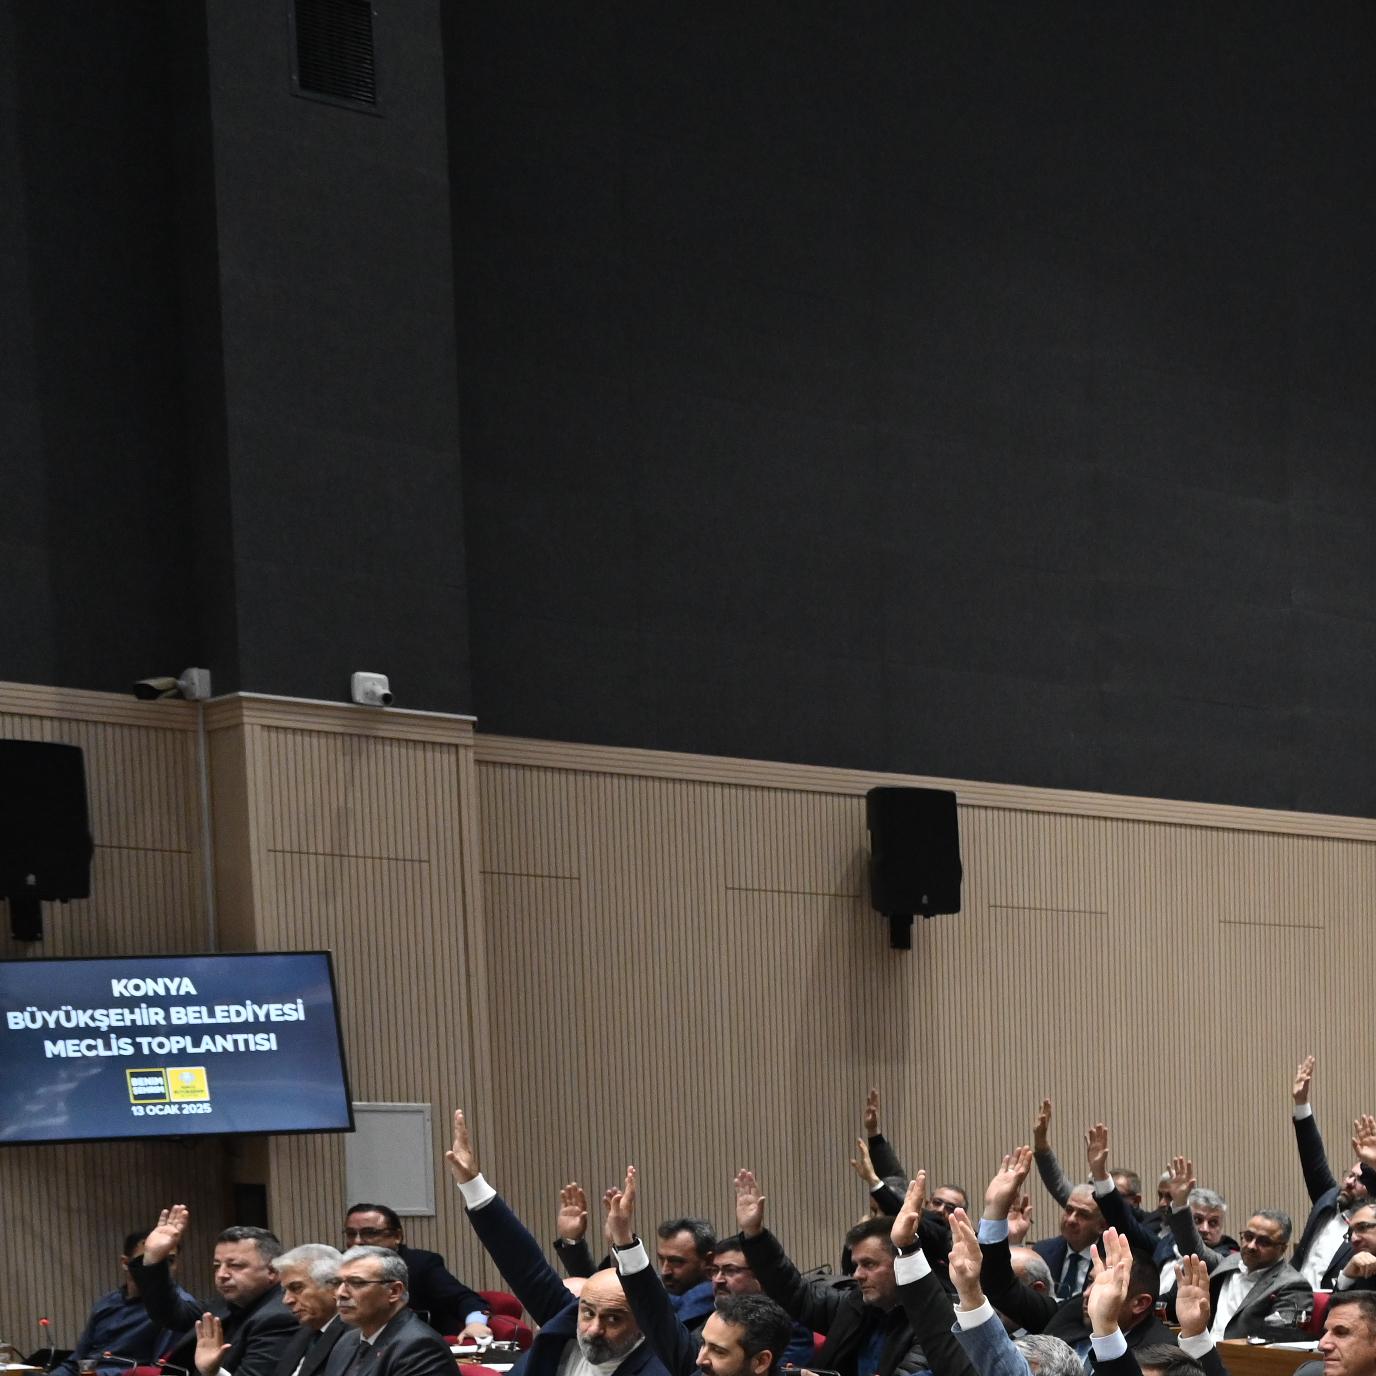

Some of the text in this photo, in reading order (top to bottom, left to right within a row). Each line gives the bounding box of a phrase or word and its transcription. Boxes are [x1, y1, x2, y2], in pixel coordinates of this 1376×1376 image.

[111, 976, 198, 997] KONYA
[6, 998, 306, 1031] BÜYÜKŞEHİR BELEDİYESİ
[43, 1032, 278, 1058] MECLİS TOPLANTISI
[131, 1103, 212, 1116] 13 OCAK 2025
